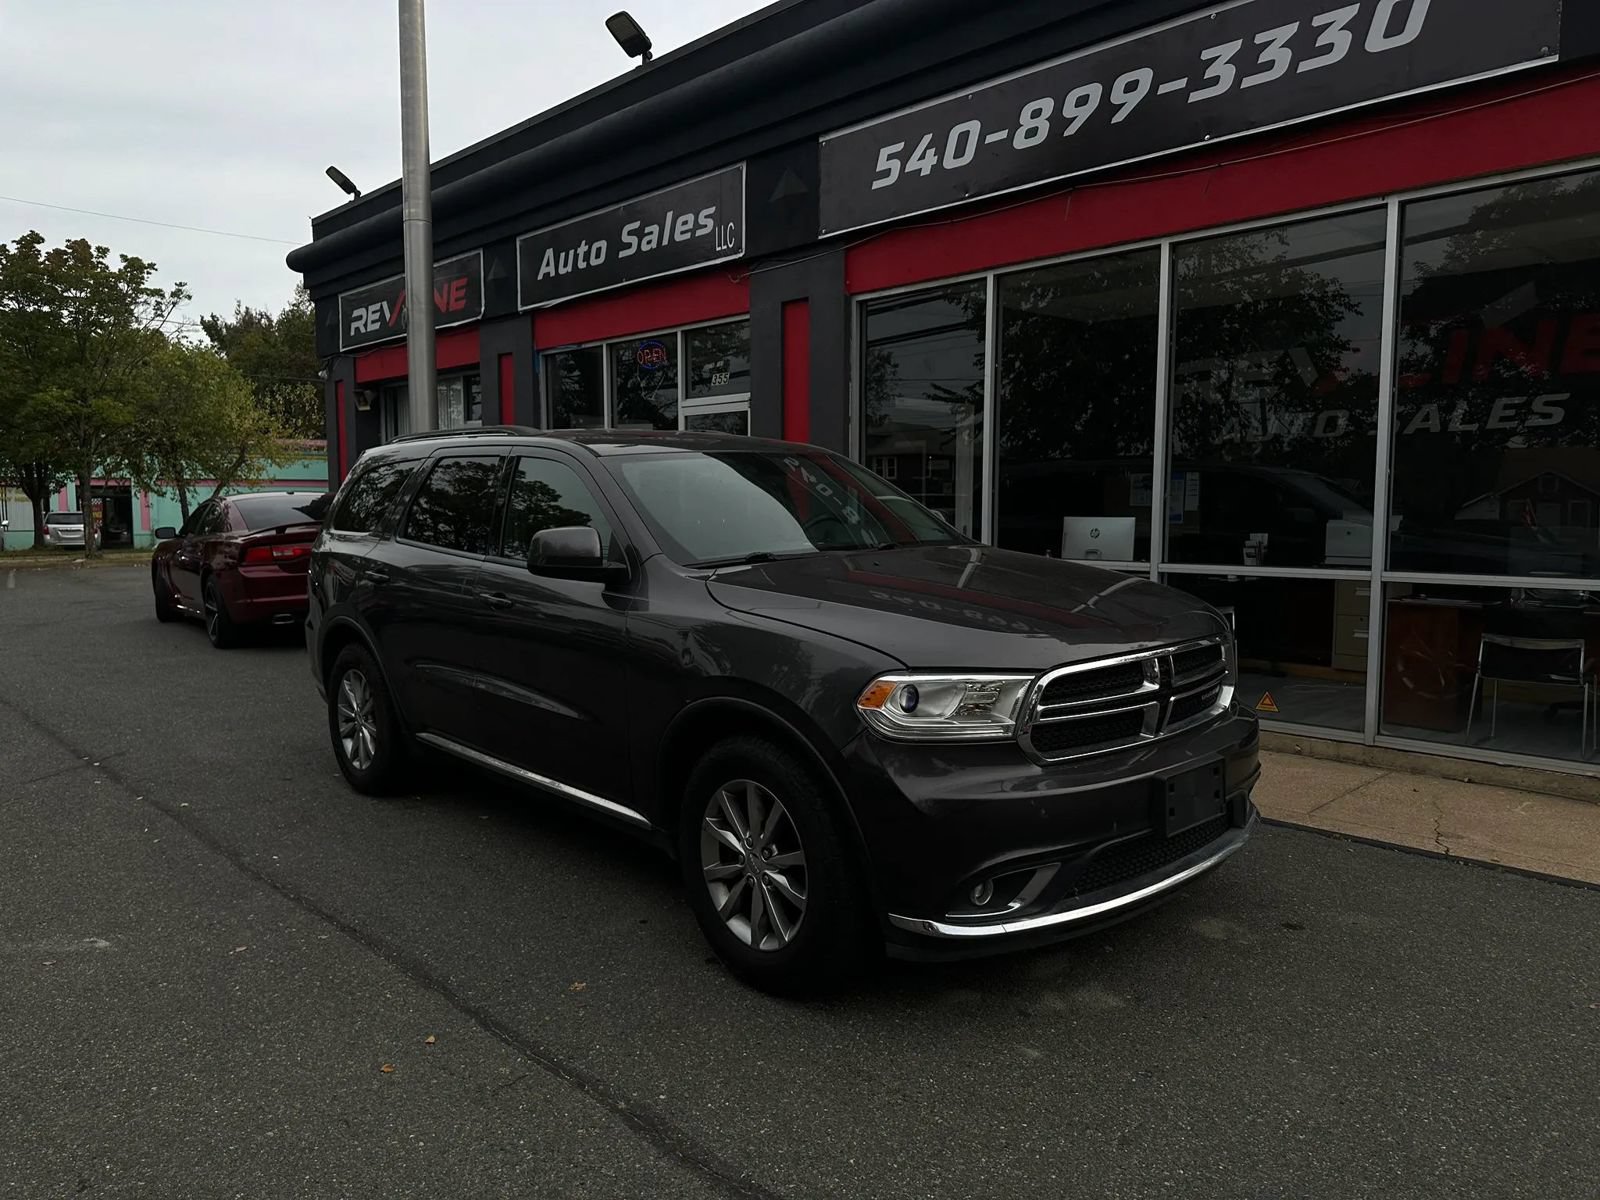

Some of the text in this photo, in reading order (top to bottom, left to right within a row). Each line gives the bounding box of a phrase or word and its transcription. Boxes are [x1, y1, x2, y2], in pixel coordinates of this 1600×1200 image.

[871, 0, 1430, 190] 540-899-3330
[537, 206, 735, 280] Auto Sales LLC
[350, 276, 468, 337] REVNE
[637, 346, 667, 365] OPEN
[712, 373, 729, 386] 355
